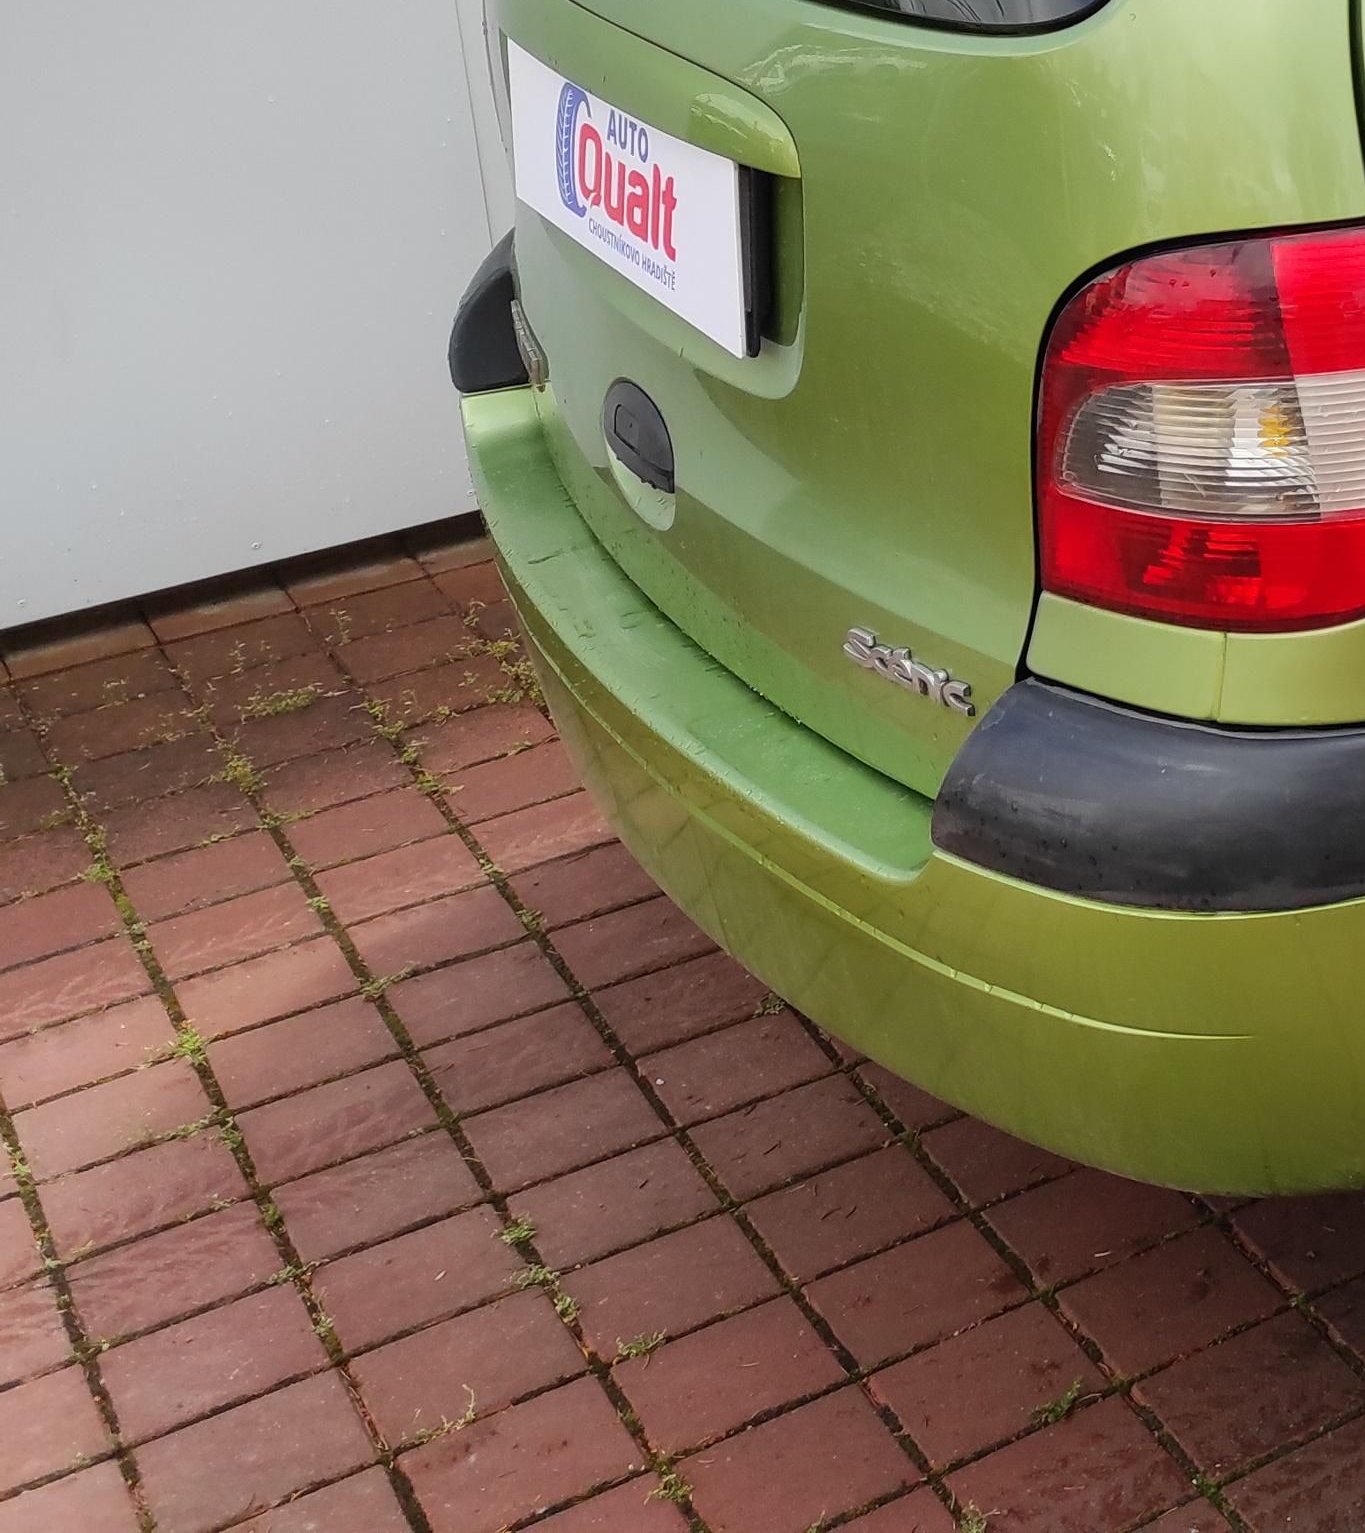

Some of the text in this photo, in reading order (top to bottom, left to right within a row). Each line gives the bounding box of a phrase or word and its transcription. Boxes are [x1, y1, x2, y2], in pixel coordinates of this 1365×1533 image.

[607, 108, 649, 163] AUTO
[578, 123, 677, 262] Qualt
[588, 218, 676, 291] CHOUSTNÍKOVO HRADIŠTĚ
